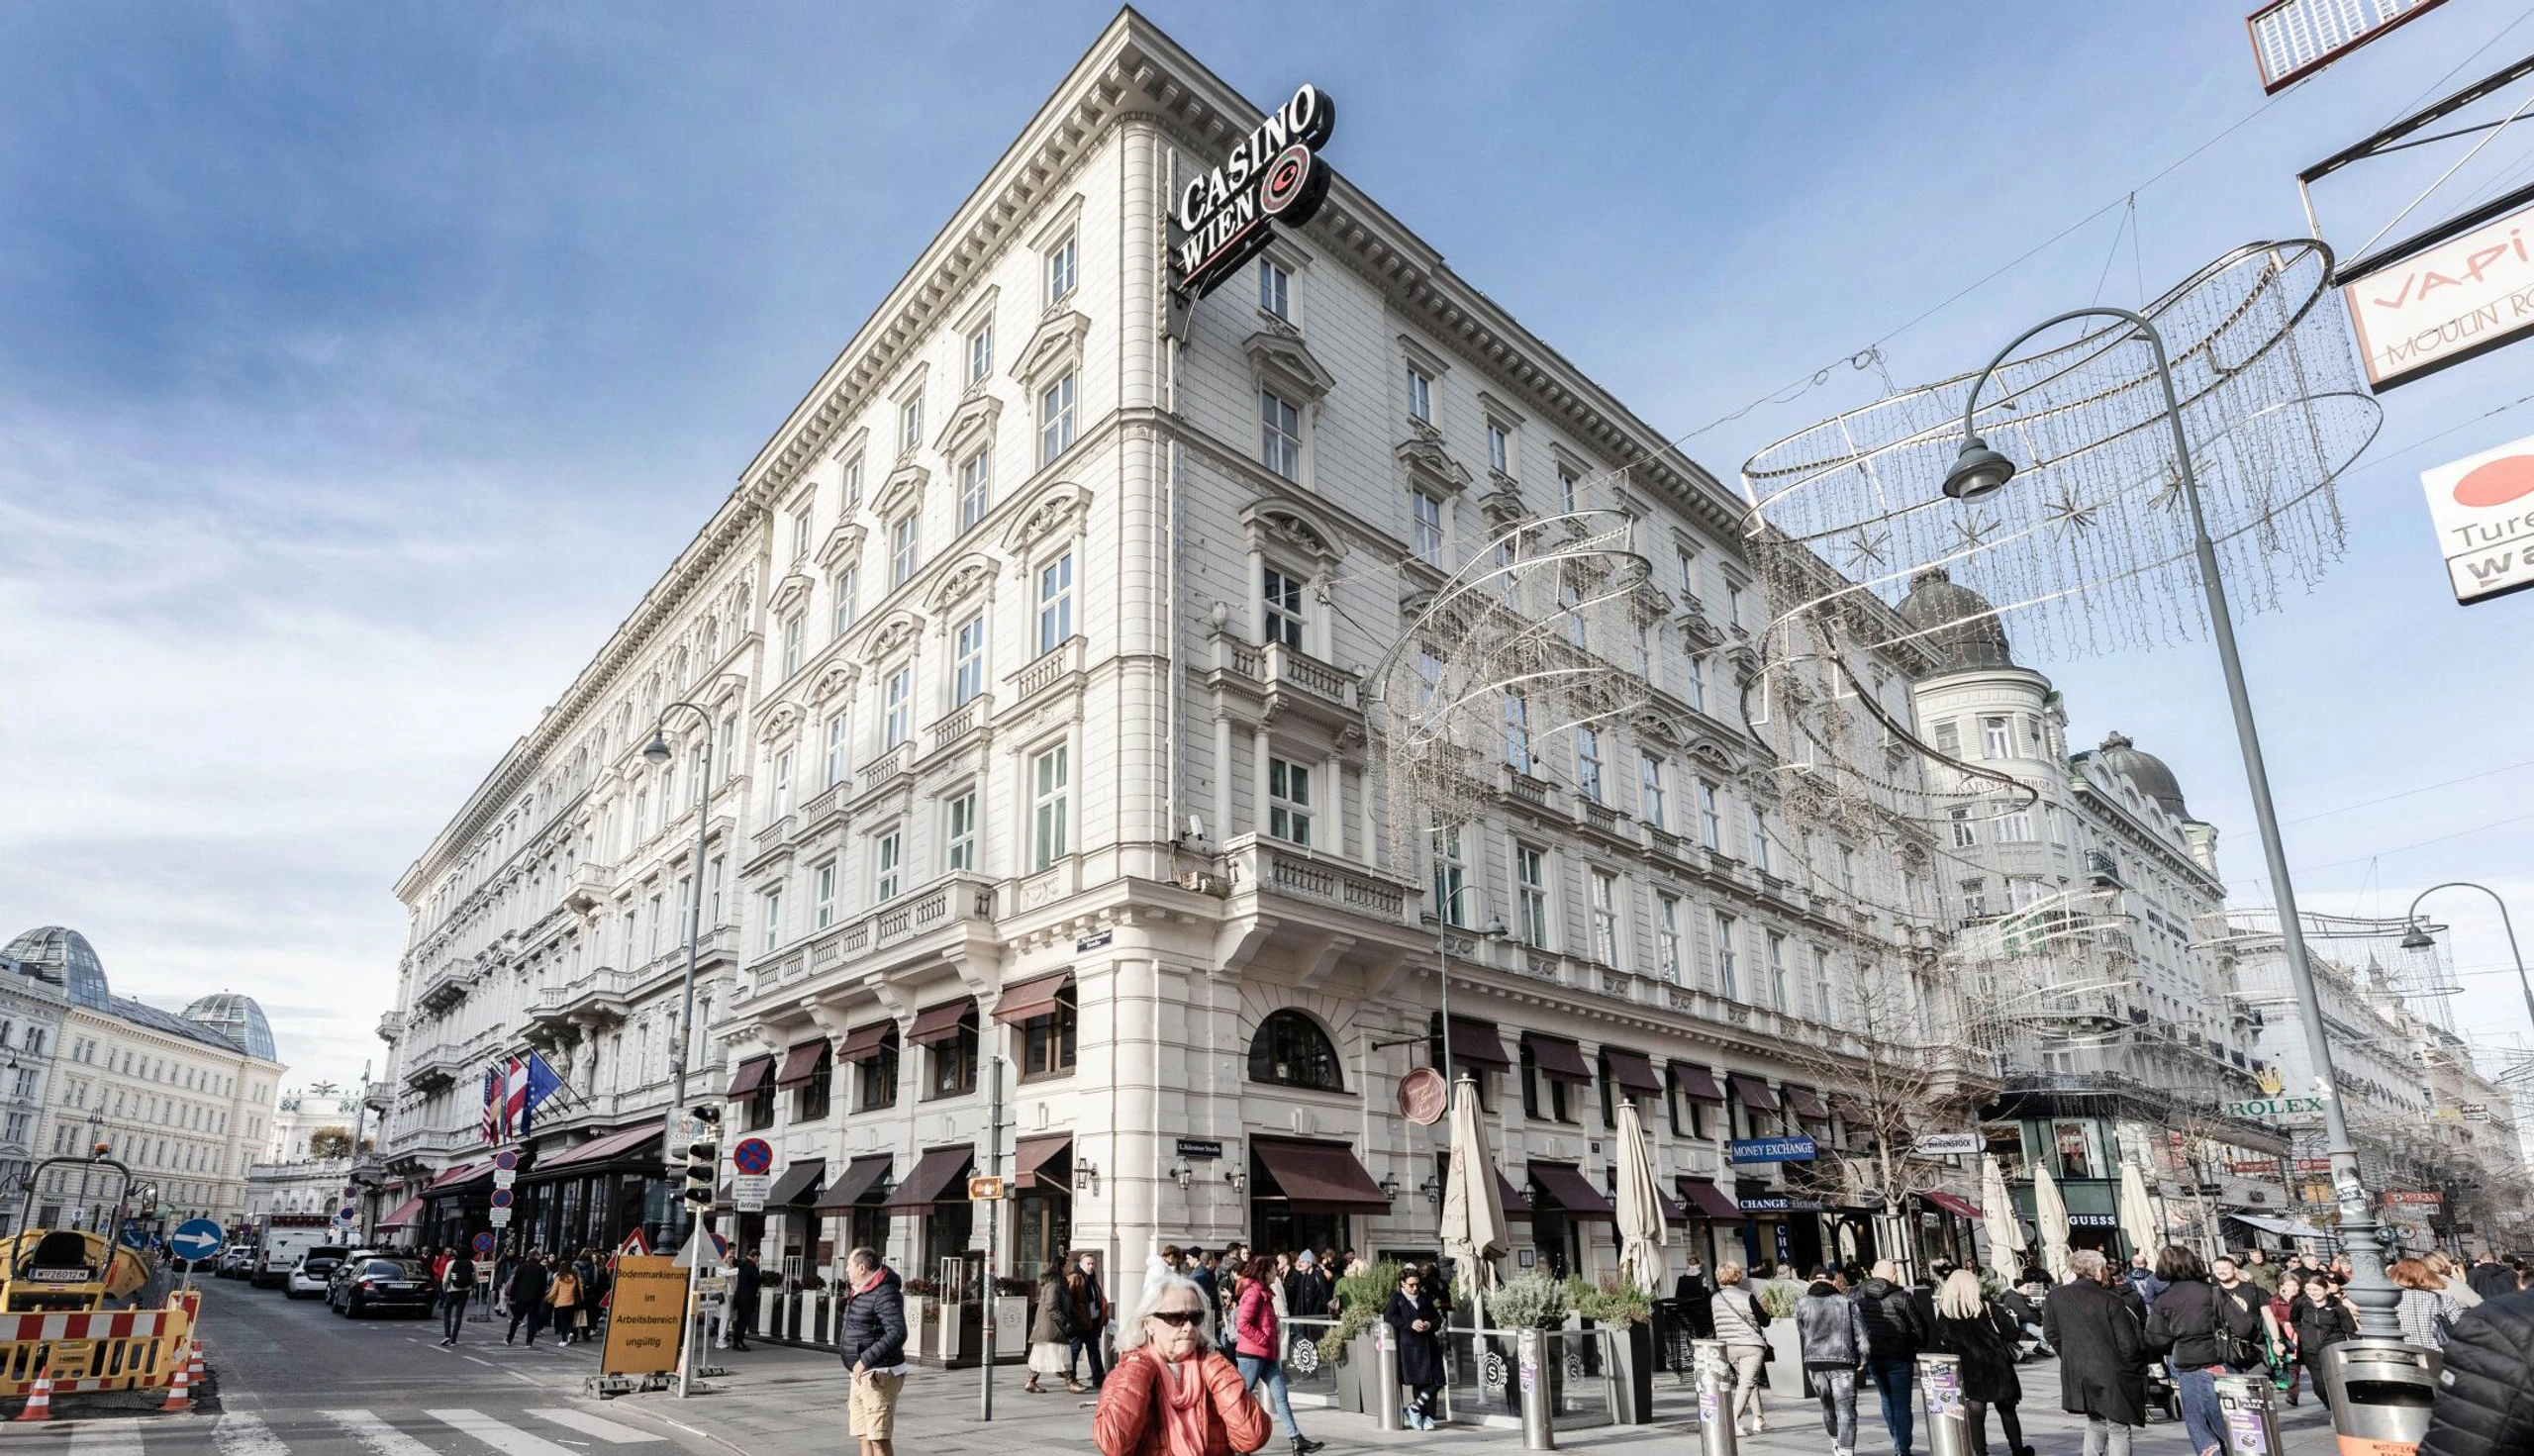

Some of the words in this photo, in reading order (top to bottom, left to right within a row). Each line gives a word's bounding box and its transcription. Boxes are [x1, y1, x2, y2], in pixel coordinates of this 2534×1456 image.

[1180, 83, 1316, 233] CASINO
[1180, 190, 1254, 275] WIEN
[2386, 302, 2499, 365] MOULIN
[2226, 1096, 2324, 1116] ROLEX
[1733, 1144, 1765, 1157] MONEY
[1766, 1142, 1814, 1156] EXCHANGE
[1740, 1199, 1788, 1209] CHANGE
[2069, 1215, 2116, 1226] GUESS
[617, 1269, 689, 1281] Bodenmarkierung
[644, 1293, 655, 1303] im
[617, 1314, 678, 1324] Arbeitsbereich
[626, 1336, 661, 1348] ungültig
